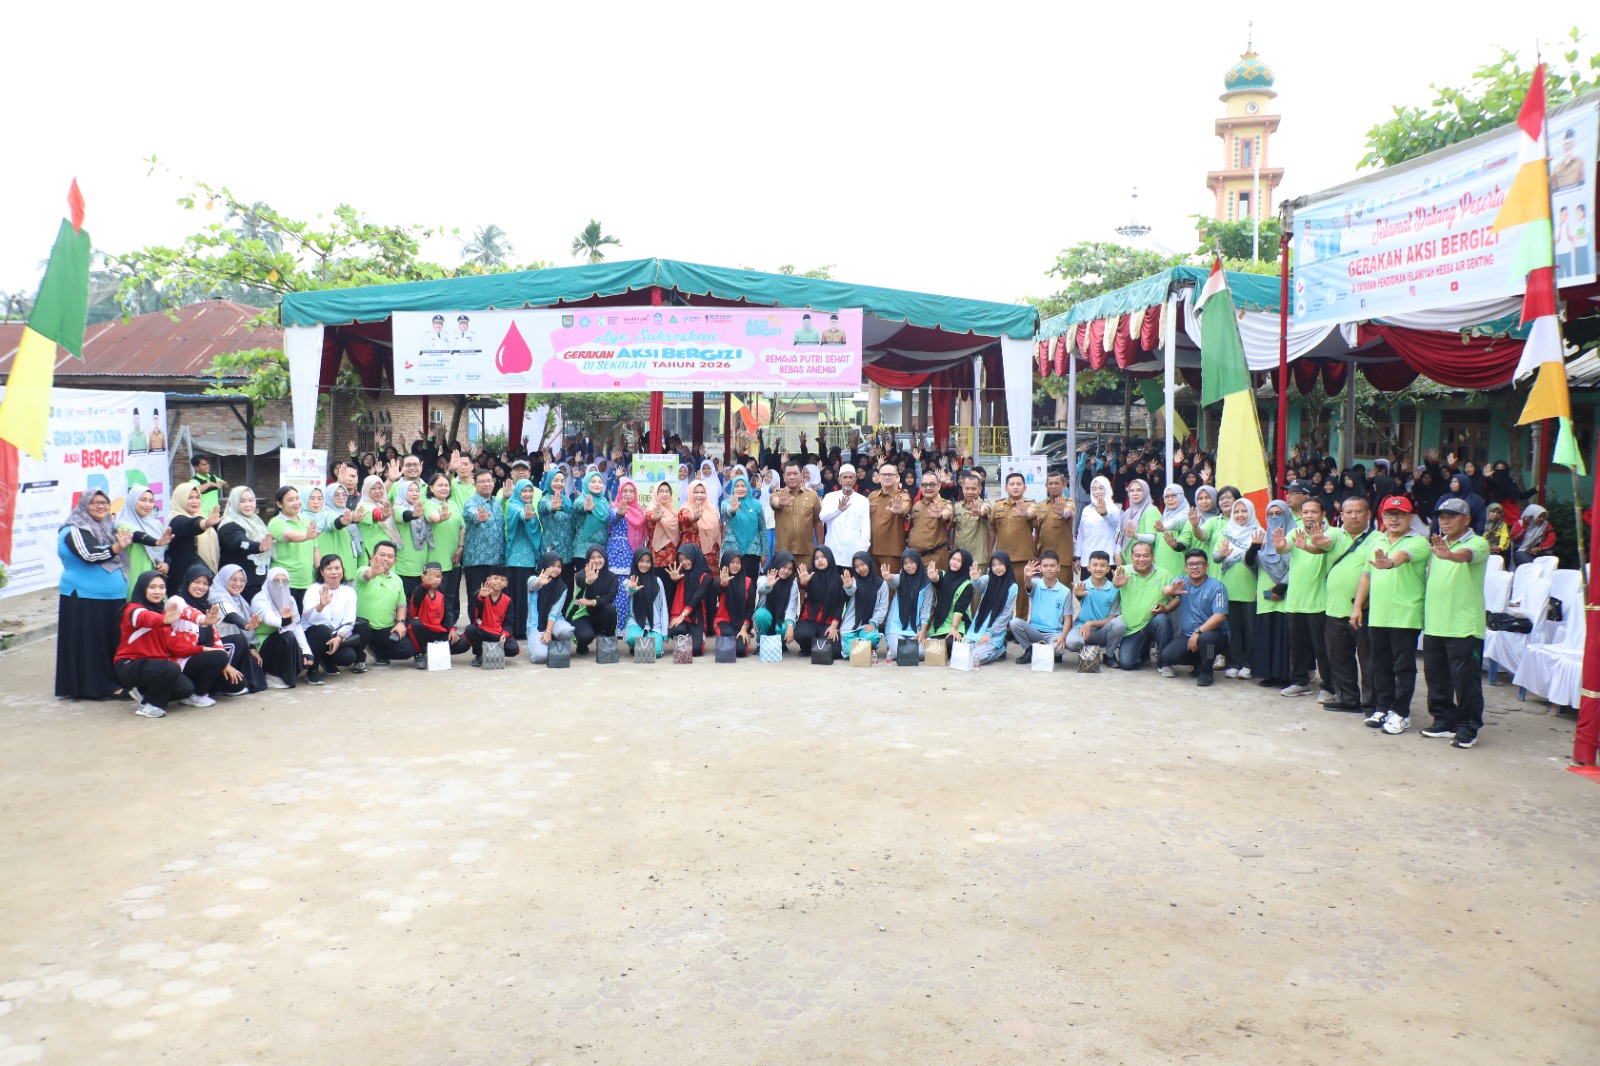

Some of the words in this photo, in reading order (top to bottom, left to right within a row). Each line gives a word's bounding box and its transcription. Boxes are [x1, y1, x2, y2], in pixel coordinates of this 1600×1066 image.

[1372, 210, 1413, 246] Selamat
[1415, 203, 1457, 231] Datang
[1459, 184, 1505, 215] Peserta
[1348, 248, 1403, 278] GERAKAN
[1406, 239, 1437, 265] AKSI
[1441, 226, 1500, 257] BERGIZI
[1357, 277, 1378, 293] YAYASAN
[1377, 272, 1408, 289] PENDIDIKAN
[1407, 264, 1436, 282] ISLAMIYAH
[1435, 261, 1454, 277] HESSA
[1455, 259, 1467, 272] AIR
[1466, 253, 1495, 271] GENTING
[593, 329, 630, 344] Ayo
[634, 328, 718, 344] Sukseskan
[563, 350, 615, 360] GERAKAN
[616, 347, 659, 359] AKSI
[661, 347, 742, 361] BERGIZI
[765, 355, 798, 364] REMAJA
[800, 355, 823, 364] PUTRI
[825, 355, 850, 364] SEHAT
[583, 361, 594, 370] DI
[597, 361, 647, 370] SEKOLAH
[652, 361, 695, 369] TAHUN
[700, 361, 731, 369] 2026
[779, 365, 804, 374] BEBAS
[807, 365, 836, 374] ANEMIA
[64, 450, 80, 465] AKSI
[81, 448, 125, 470] BERGIZI
